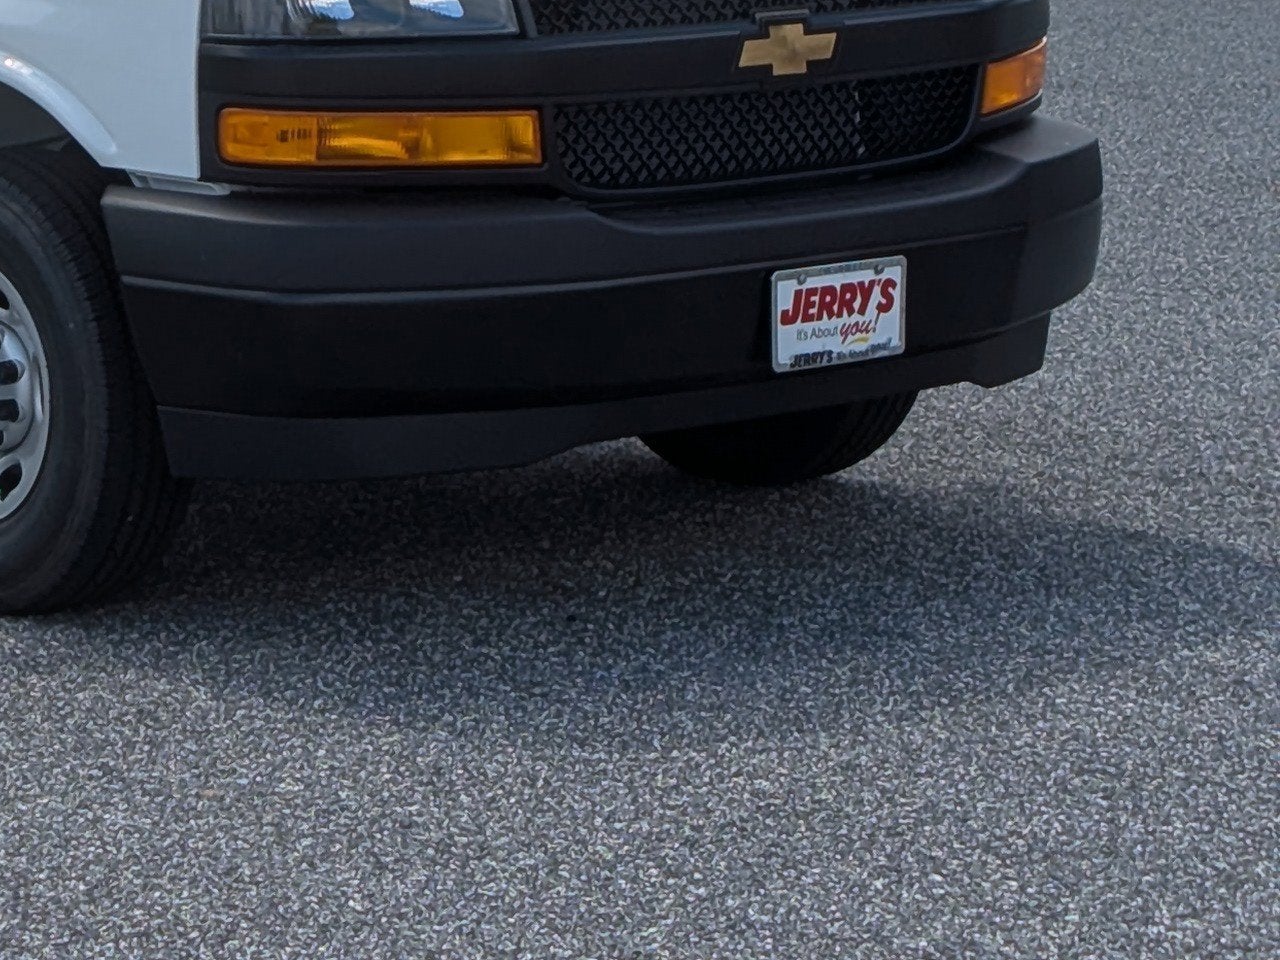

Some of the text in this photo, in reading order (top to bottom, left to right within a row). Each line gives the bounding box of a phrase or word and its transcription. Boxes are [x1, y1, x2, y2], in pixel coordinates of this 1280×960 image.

[780, 277, 898, 326] JERRY'S
[796, 328, 809, 342] It's
[839, 311, 881, 345] you!
